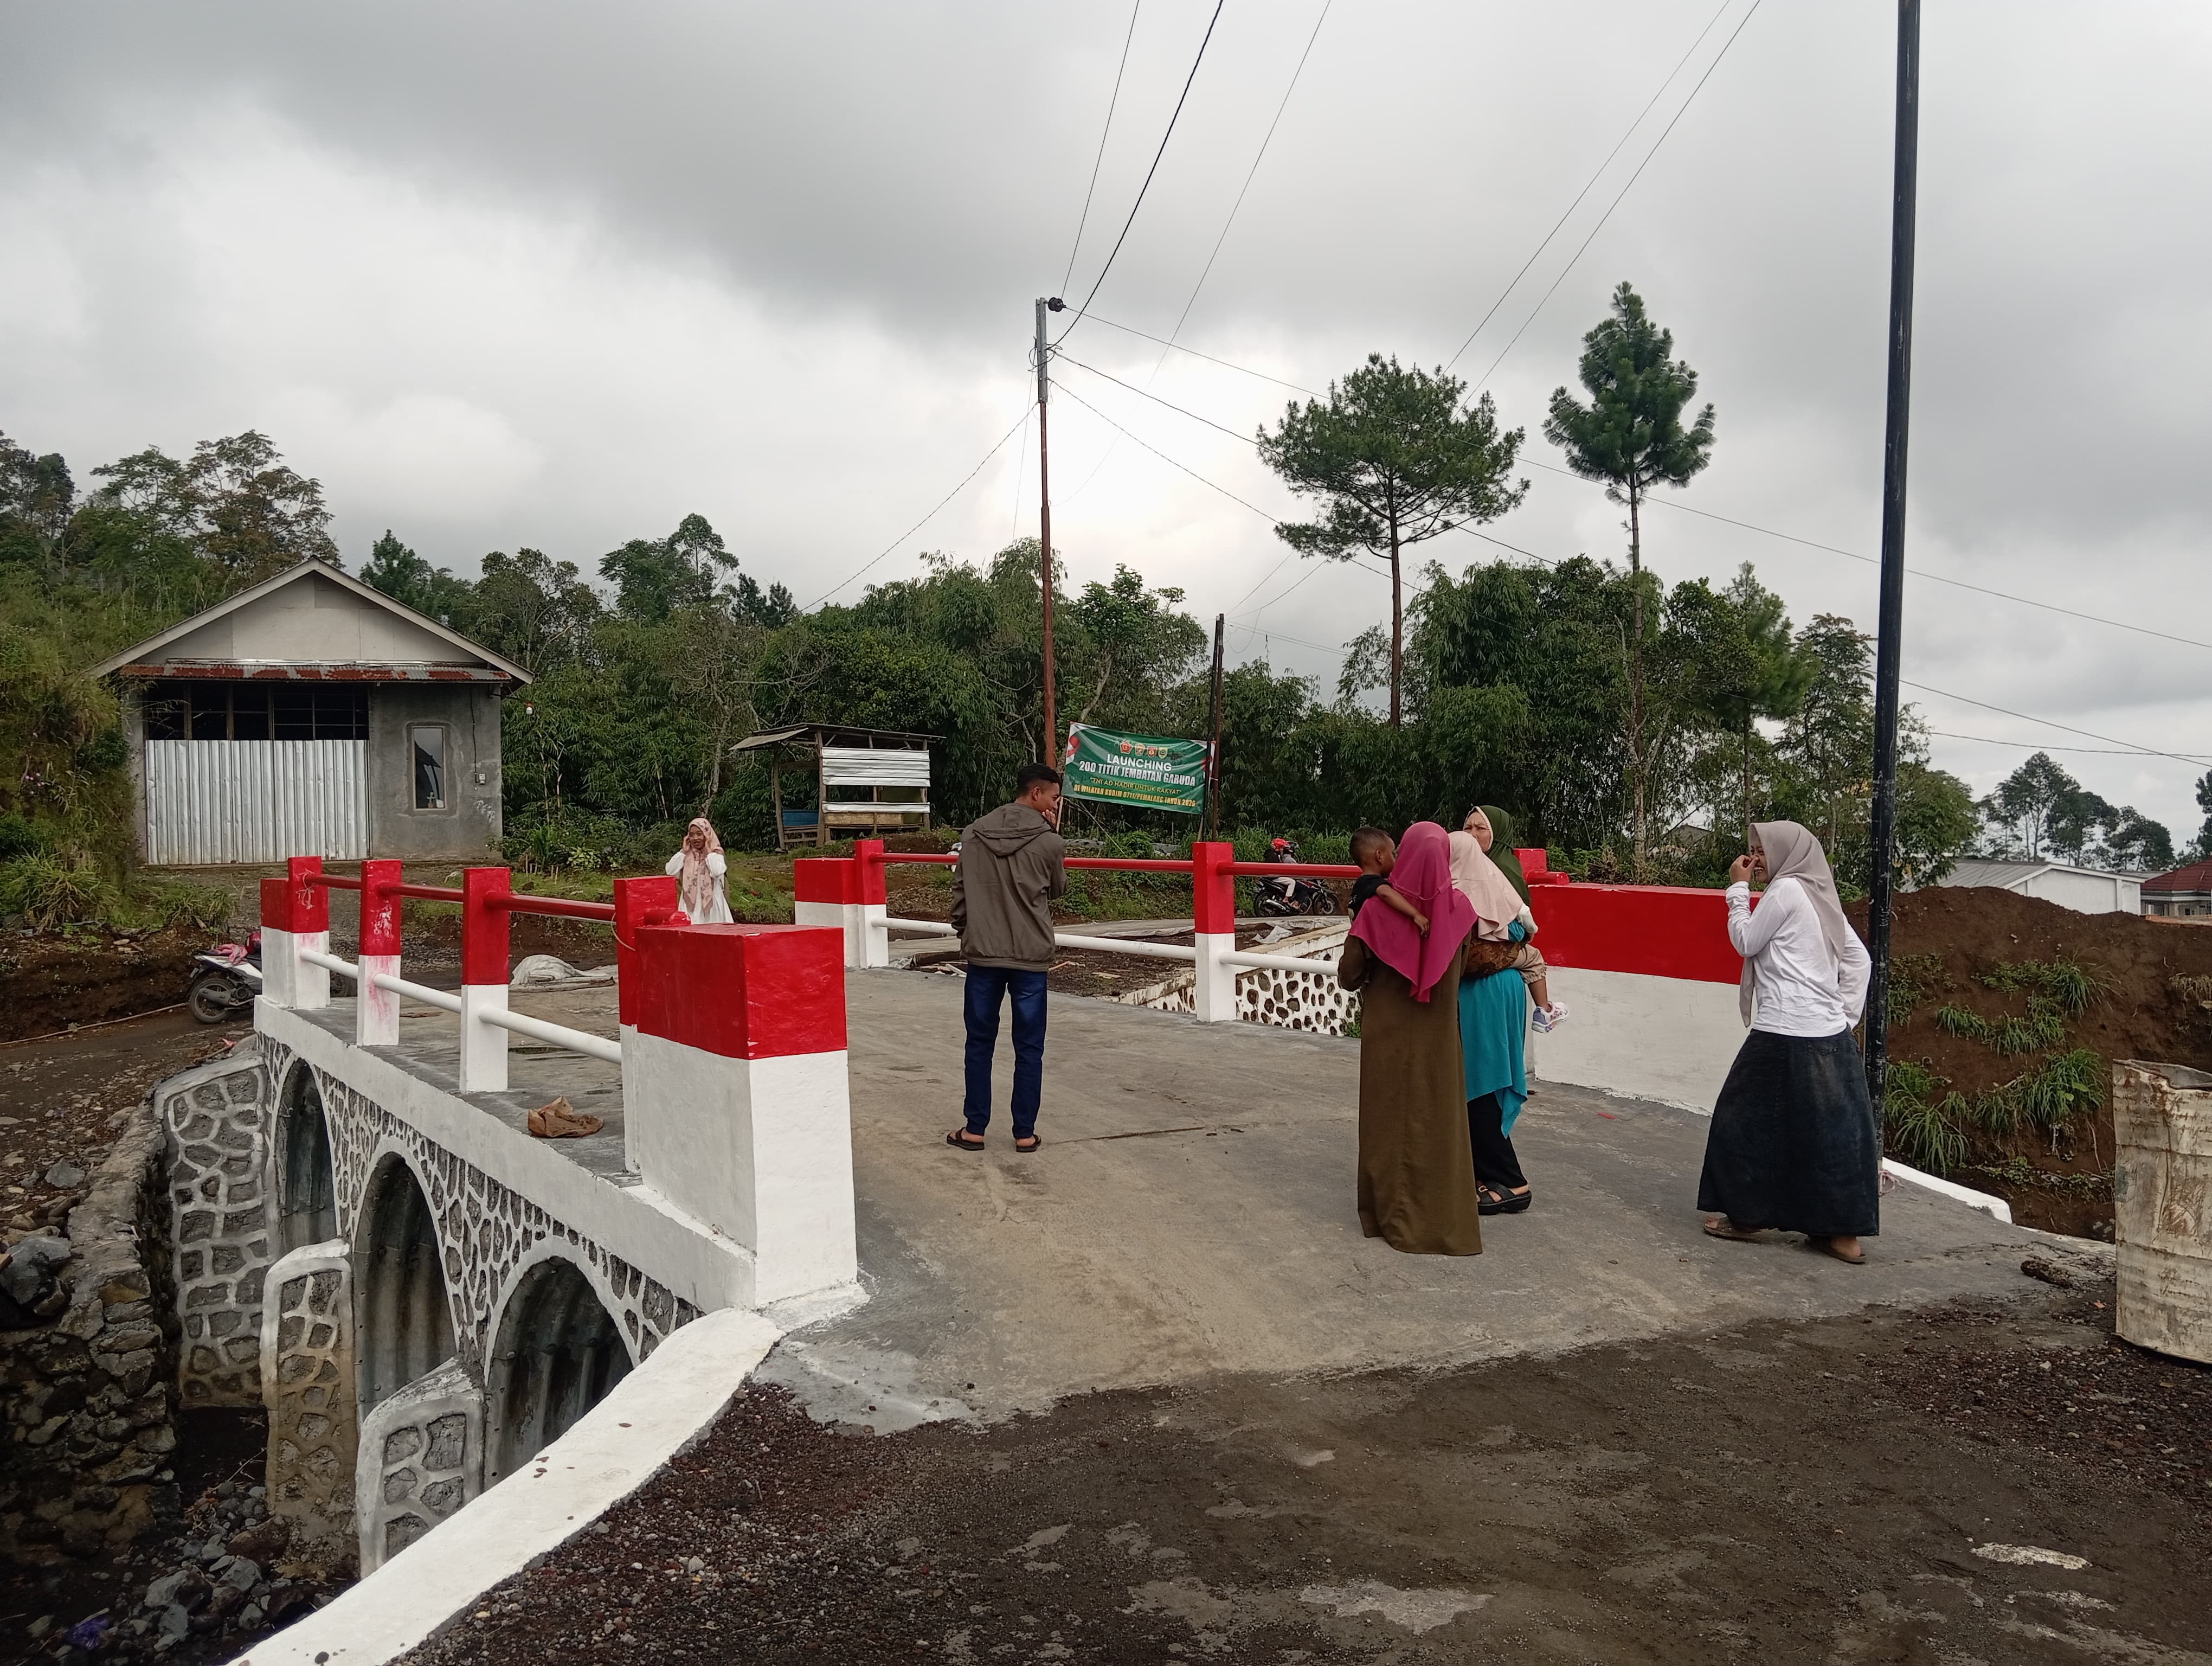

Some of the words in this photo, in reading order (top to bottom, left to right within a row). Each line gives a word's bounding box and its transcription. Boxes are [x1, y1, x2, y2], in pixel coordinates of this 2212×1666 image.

[1107, 754, 1172, 771] LAUNCHING
[1079, 761, 1096, 772] 200
[1098, 764, 1120, 776] TITIK
[1121, 767, 1162, 782] JEMBATAN
[1163, 773, 1195, 786] GARUDA
[1115, 781, 1133, 790] HADIR
[1081, 785, 1104, 794] WILAYAH
[1165, 797, 1181, 805] TAHUN
